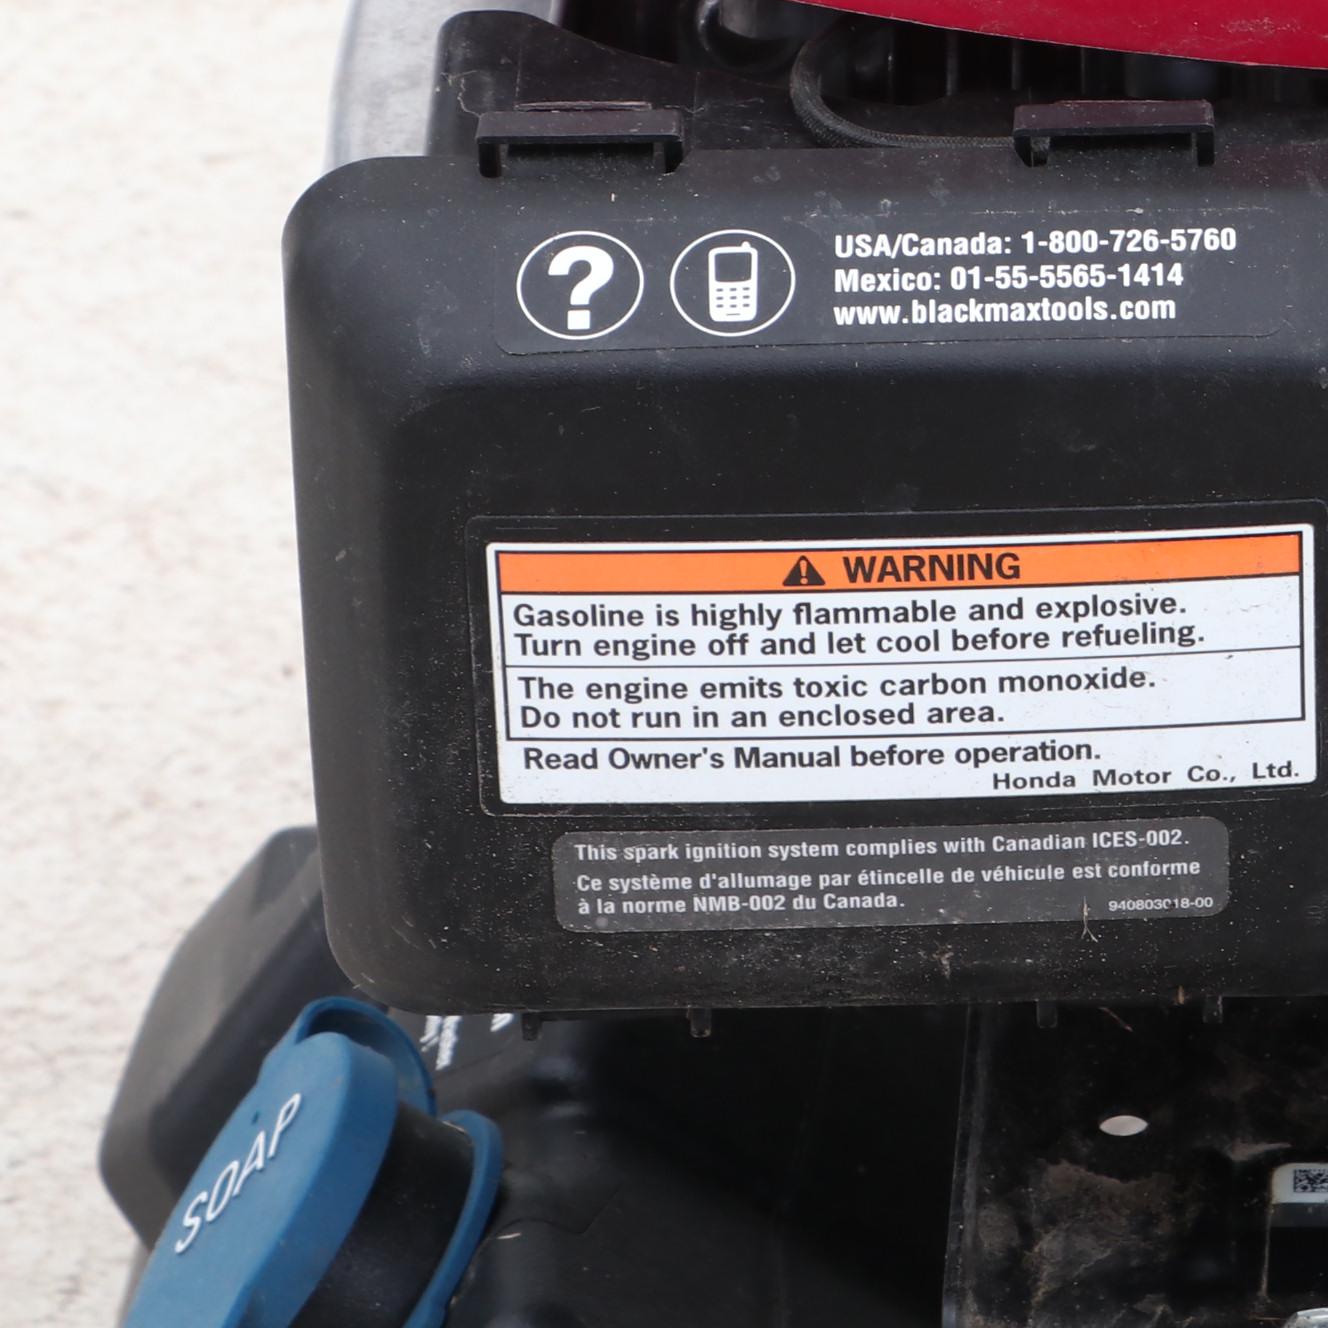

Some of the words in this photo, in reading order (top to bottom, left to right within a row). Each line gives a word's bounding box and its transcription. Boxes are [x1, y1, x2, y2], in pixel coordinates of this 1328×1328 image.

[835, 232, 1012, 258] USA/Canada:
[1022, 228, 1236, 253] 1-800-726-5760
[835, 266, 940, 292] Mexico:
[951, 263, 1183, 290] 01-55-5565-1414
[834, 296, 1175, 325] www.blackmaxtools.com
[843, 553, 1020, 583] WARNING
[514, 604, 643, 626] Gasoline
[656, 604, 679, 626] is
[692, 603, 782, 631] highly
[793, 600, 956, 624] flammable
[969, 597, 1023, 621] and
[1036, 593, 1185, 623] explosive.
[514, 633, 581, 656] Turn
[594, 636, 695, 661] engine
[709, 633, 748, 655] off
[761, 632, 815, 655] and
[828, 632, 865, 653] let
[877, 629, 939, 653] cool
[952, 628, 1049, 651] before
[1063, 622, 1204, 647] refueling.
[518, 677, 573, 699] The
[586, 679, 688, 704] engine
[701, 676, 782, 699] emits
[793, 675, 867, 698] toxic
[880, 673, 986, 696] carbon
[999, 666, 1154, 692] monoxide.
[524, 748, 597, 769] Read
[609, 747, 724, 769] Owner's
[735, 746, 840, 768] Manual
[851, 744, 944, 766] before
[955, 740, 1100, 768] operation.
[993, 772, 1075, 789] Honda
[1093, 769, 1171, 786] Motor
[1188, 766, 1235, 782] Co.,
[1253, 761, 1298, 779] Ltd.
[575, 845, 617, 860] This
[624, 844, 678, 863] spark
[686, 843, 761, 862] ignition
[768, 842, 838, 861] system
[846, 839, 937, 858] complies
[944, 837, 985, 853] with
[993, 834, 1085, 851] Canadian
[1093, 829, 1188, 848] ICES-002.
[578, 875, 602, 891] Ce
[609, 874, 692, 893] système
[700, 873, 811, 890] d'allumage
[819, 874, 851, 889] par
[858, 869, 944, 885] étincelle
[952, 868, 974, 882] de
[982, 865, 1064, 881] véhicule
[1073, 864, 1101, 878] est
[1108, 861, 1200, 877] conforme
[175, 1093, 301, 1253] SOAP
